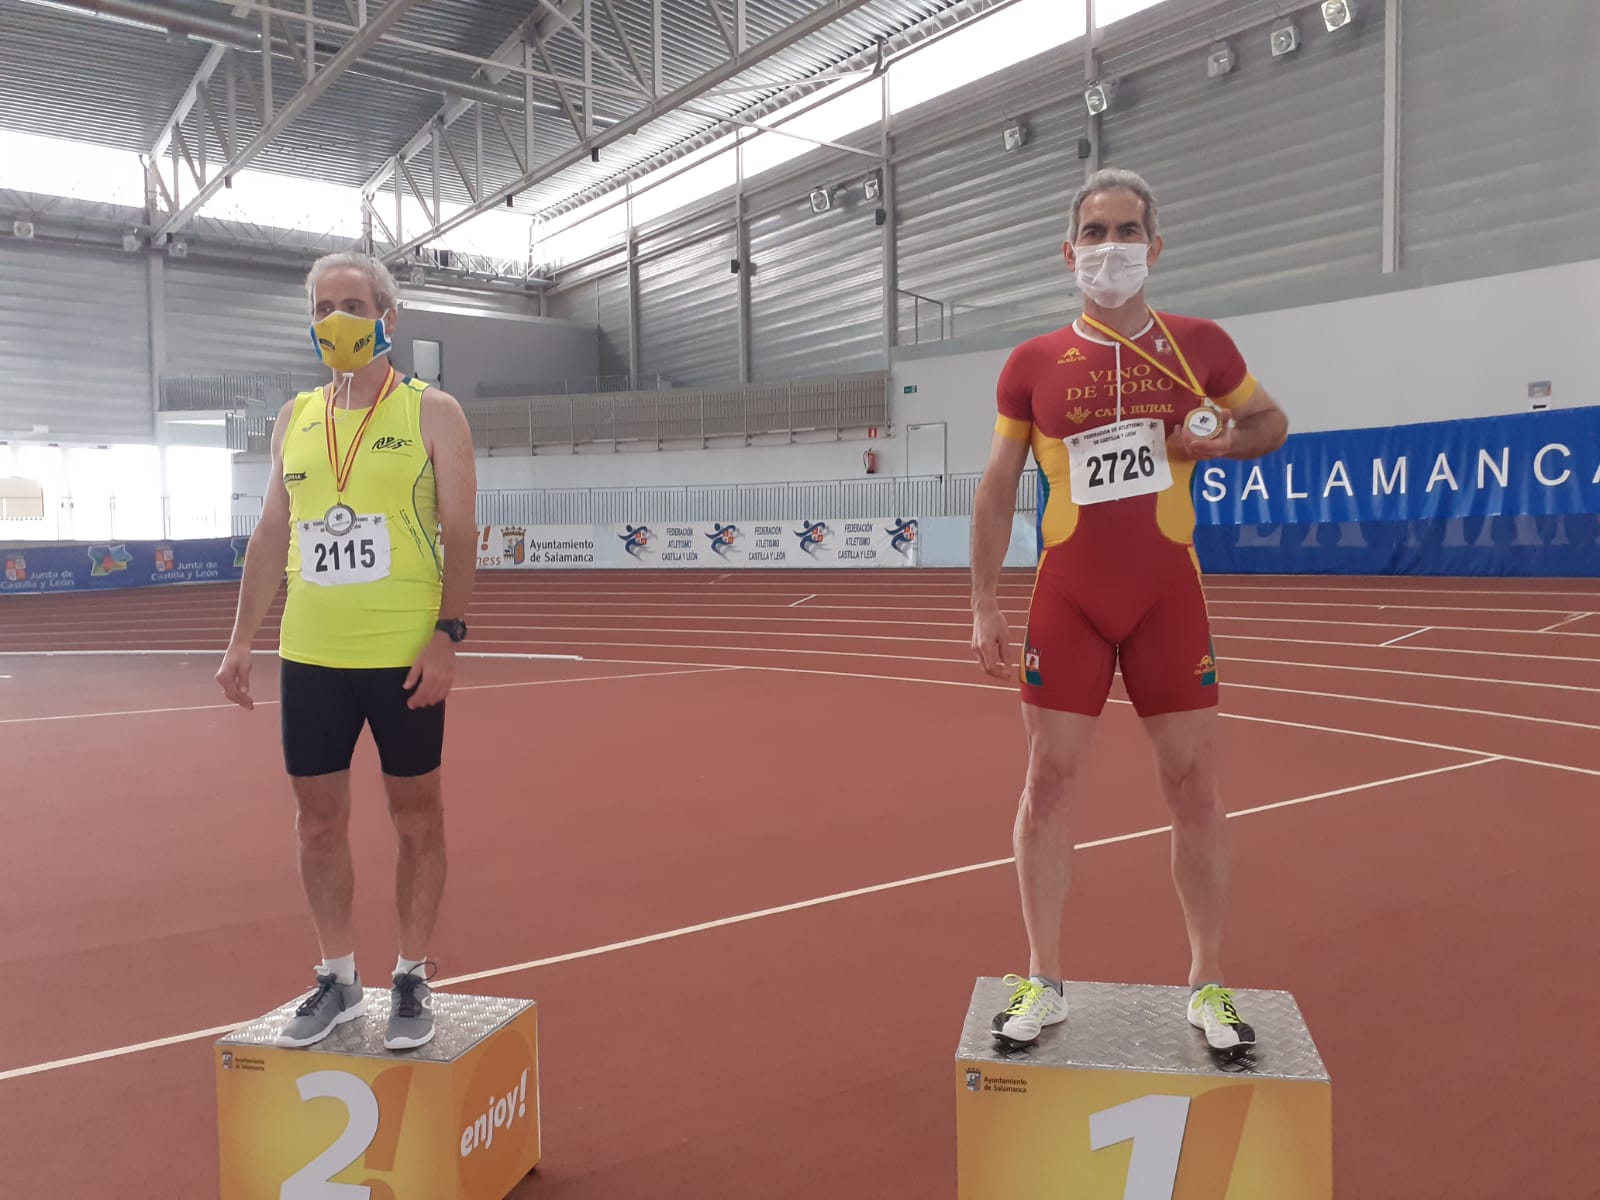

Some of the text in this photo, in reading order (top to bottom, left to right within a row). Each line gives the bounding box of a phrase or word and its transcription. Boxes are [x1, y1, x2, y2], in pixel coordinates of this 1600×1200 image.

[1088, 364, 1152, 382] VINO
[1066, 378, 1173, 401] DE TORO
[1131, 403, 1174, 414] RURAL
[1086, 445, 1155, 488] 2726
[1202, 443, 1600, 502] SALAMANC
[845, 522, 873, 532] FEDERACIÓN
[529, 539, 594, 552] Ayuntamiento
[846, 537, 870, 546] ATLETISMO
[314, 538, 376, 573] 2115
[530, 551, 594, 562] de Salamanca
[661, 552, 681, 561] CASTILLA
[748, 551, 769, 560] CASTILLA
[838, 550, 859, 559] CASTILLA
[178, 560, 218, 570] Junta de
[30, 569, 73, 580] Junta de
[151, 570, 185, 581] Castilla
[195, 568, 218, 578] León
[1, 580, 37, 590] Castilla
[984, 1076, 1027, 1086] Ayuntamiento
[994, 1084, 1027, 1093] Salamanca
[461, 1068, 528, 1157] enjoy!
[280, 1070, 379, 1200] 2
[1089, 1094, 1191, 1200] 1
